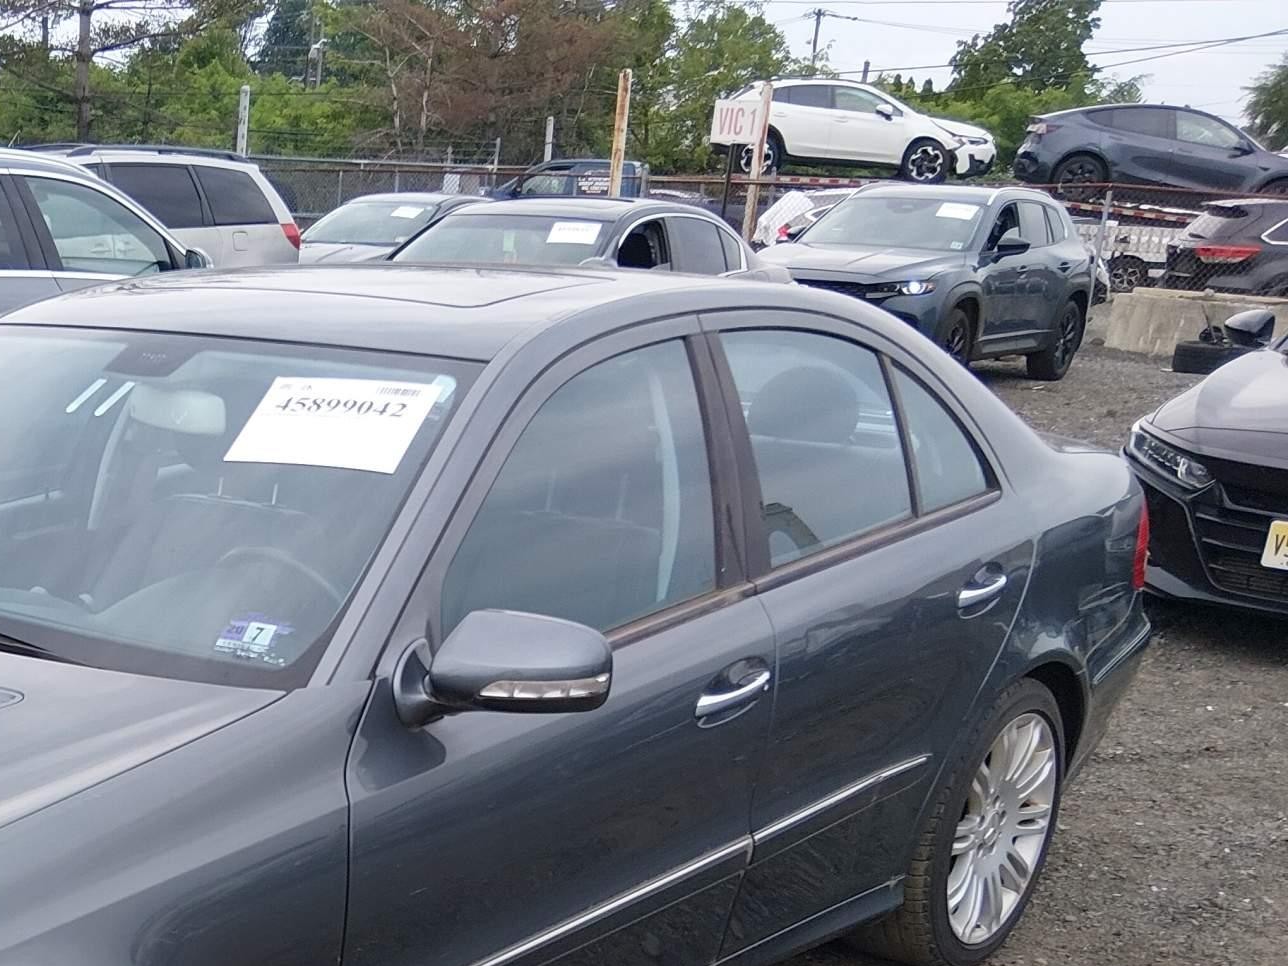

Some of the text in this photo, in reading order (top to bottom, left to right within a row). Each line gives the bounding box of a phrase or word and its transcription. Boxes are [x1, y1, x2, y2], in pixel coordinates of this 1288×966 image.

[719, 107, 757, 136] VIC 1
[275, 396, 408, 418] 45899042
[252, 626, 265, 642] 7
